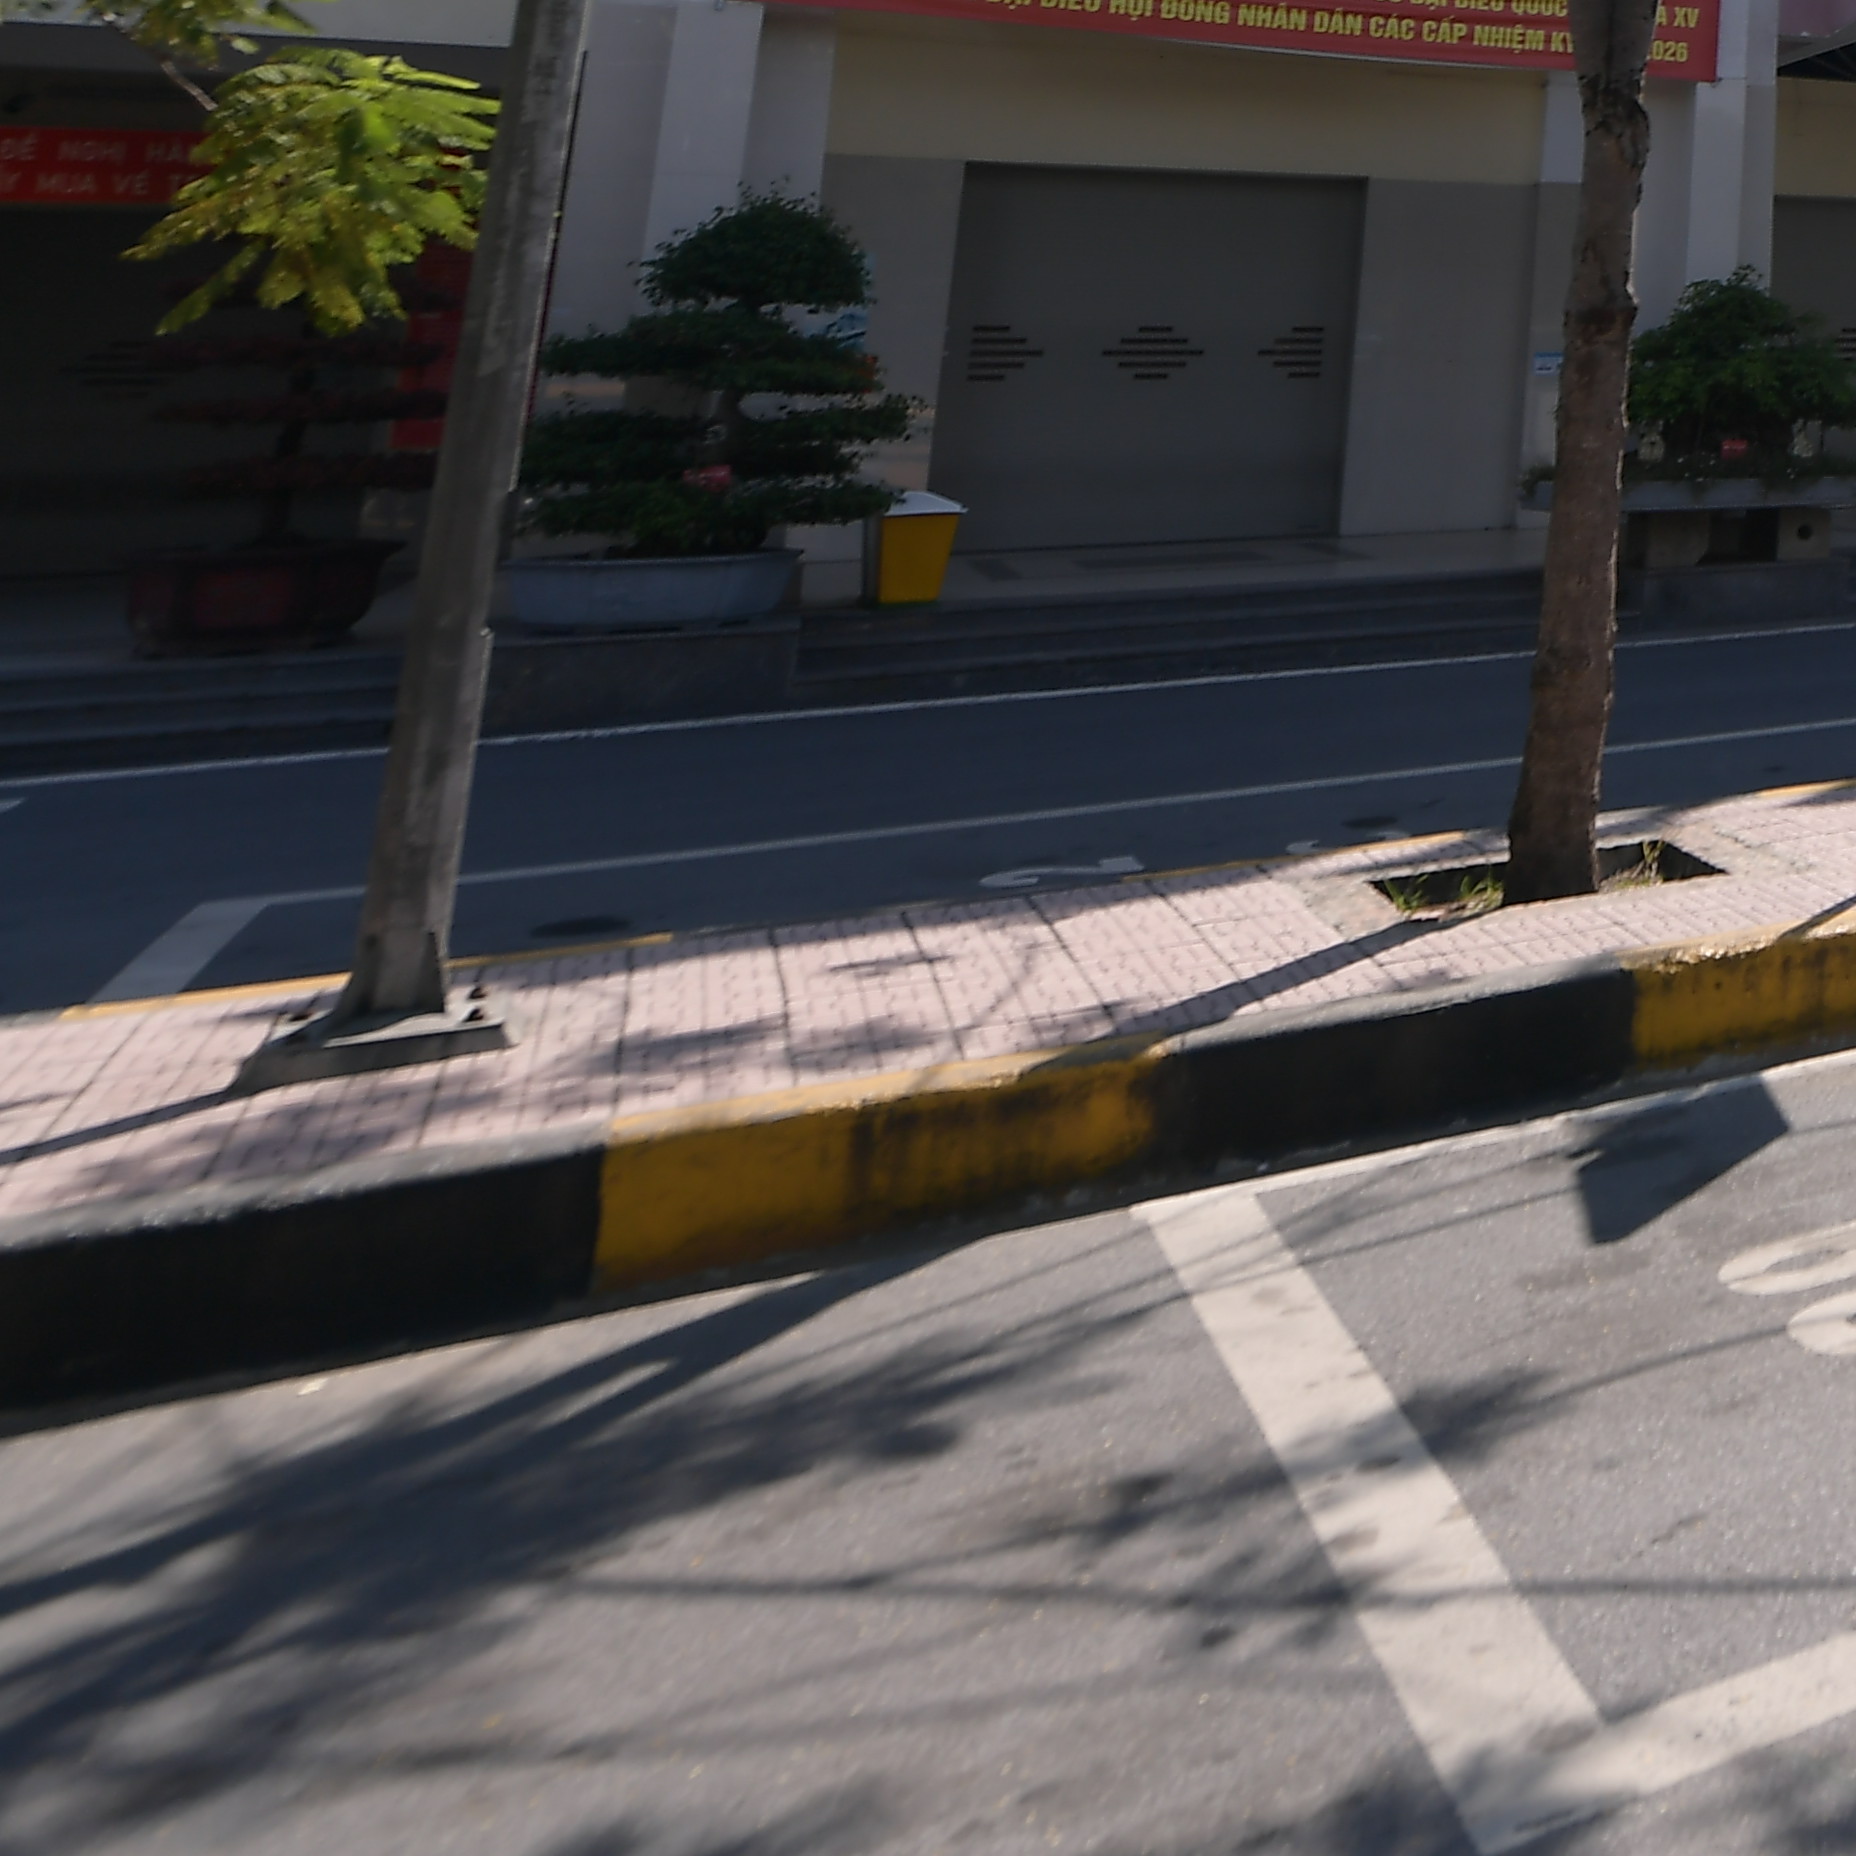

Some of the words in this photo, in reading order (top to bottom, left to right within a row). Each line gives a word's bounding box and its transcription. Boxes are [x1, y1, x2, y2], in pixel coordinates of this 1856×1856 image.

[1237, 2, 1307, 33] NHÂN
[1313, 8, 1364, 36] DÂN
[1369, 14, 1415, 41] CÁC
[1422, 16, 1468, 44] CẤP
[1473, 24, 1546, 54] NHIỆM
[1674, 6, 1700, 29] XV
